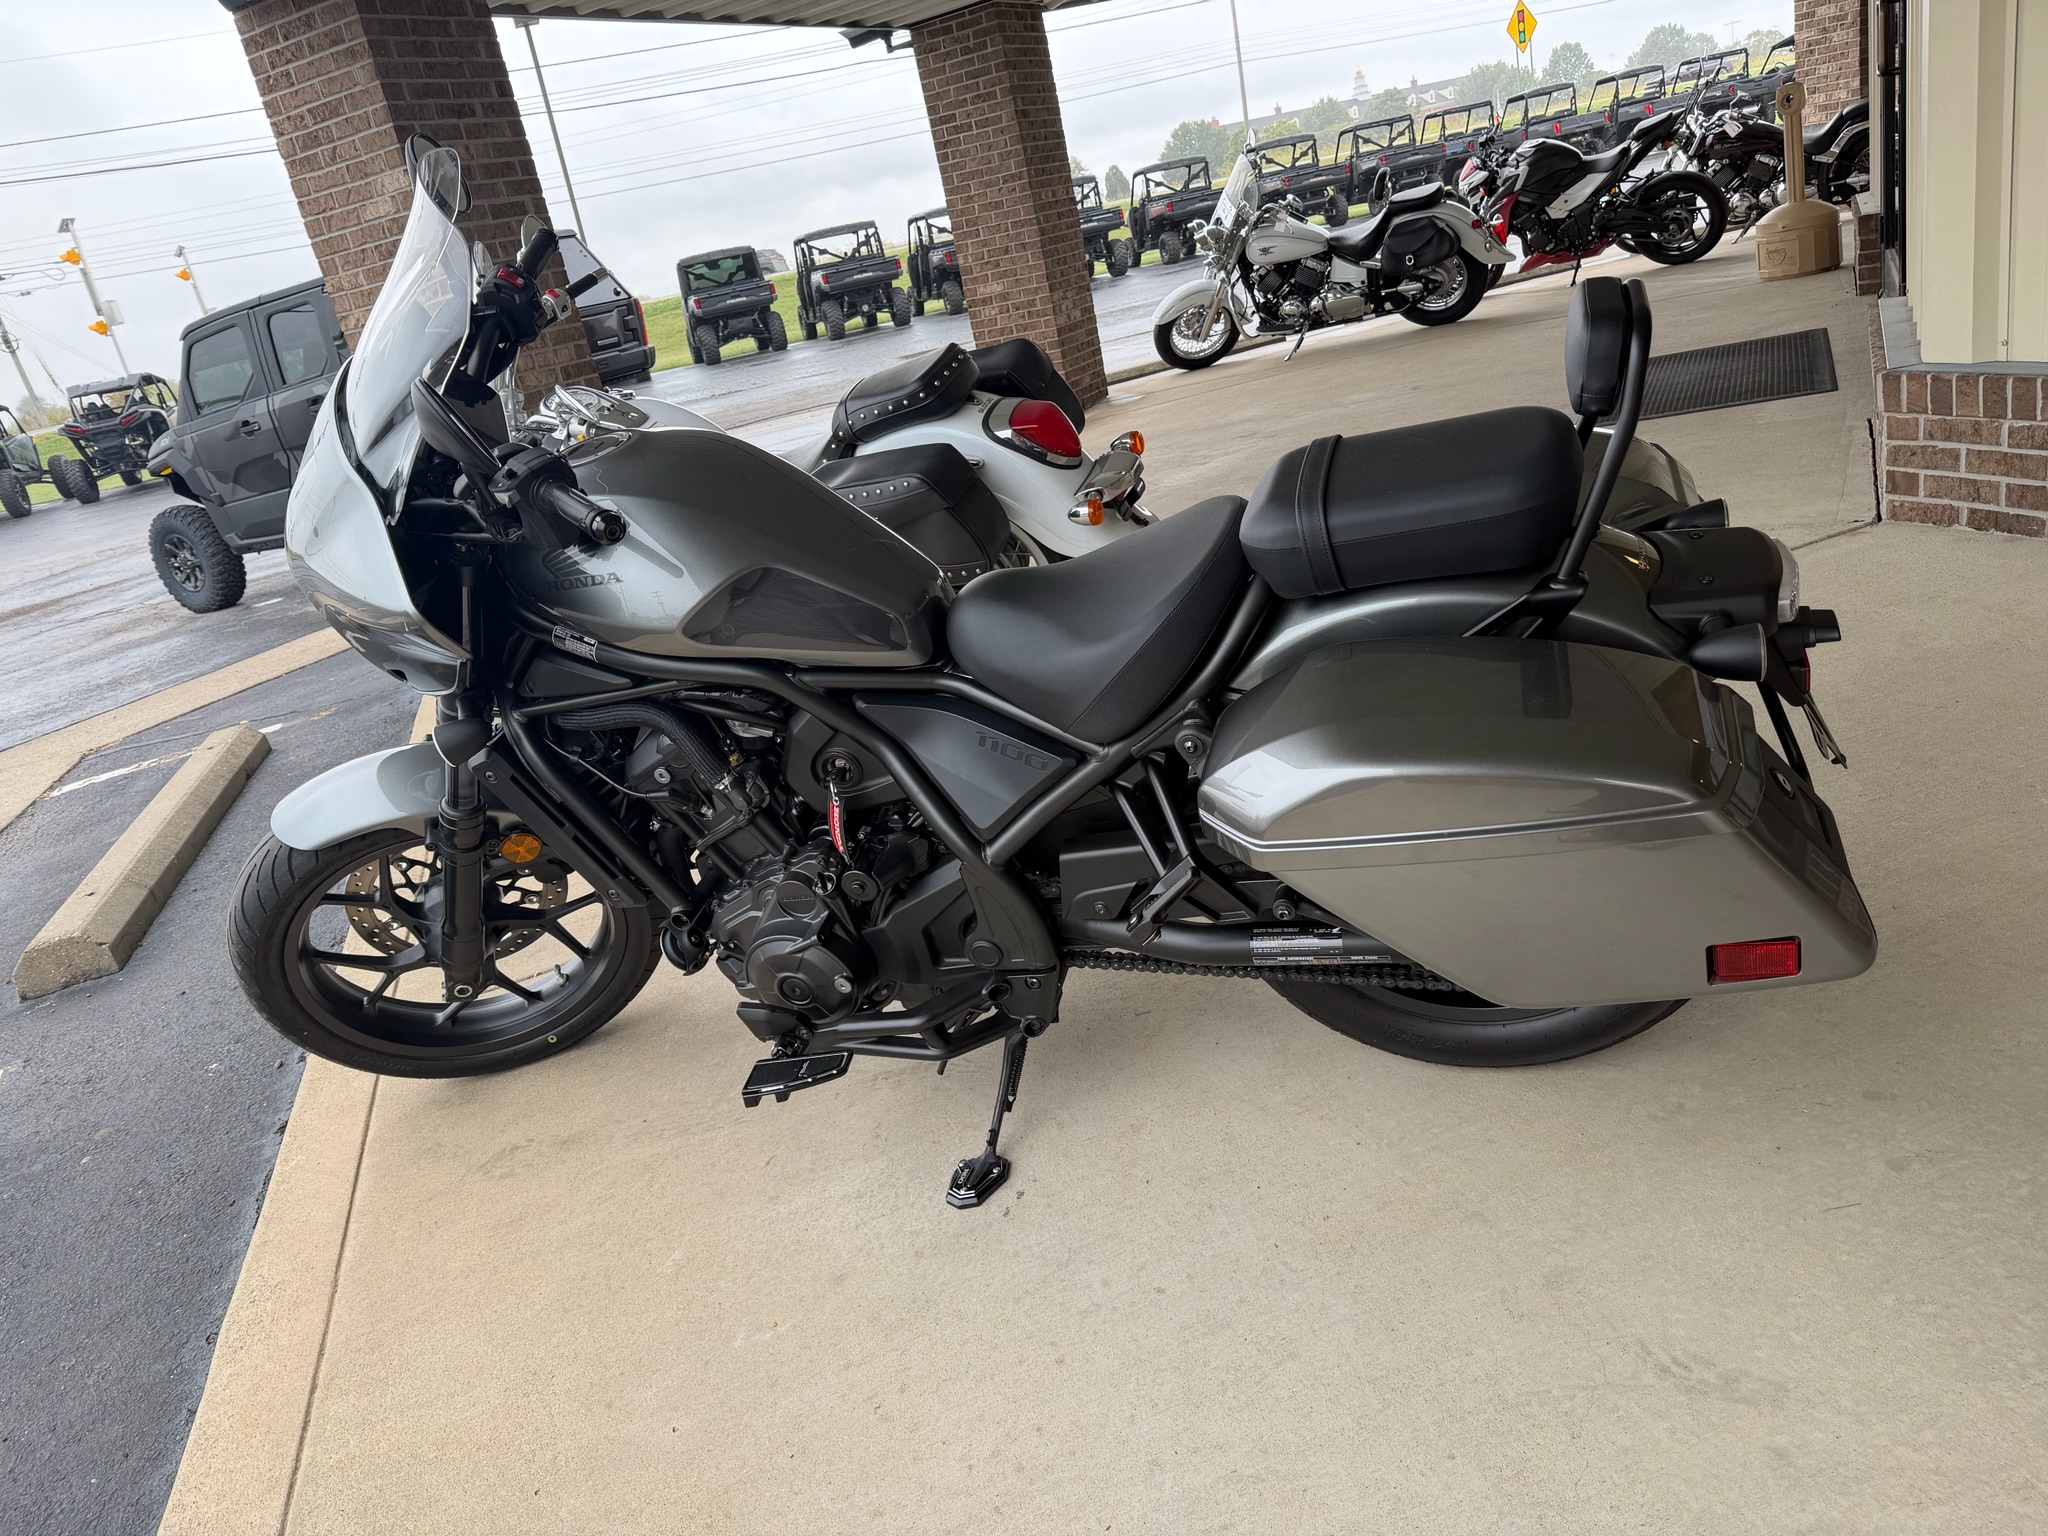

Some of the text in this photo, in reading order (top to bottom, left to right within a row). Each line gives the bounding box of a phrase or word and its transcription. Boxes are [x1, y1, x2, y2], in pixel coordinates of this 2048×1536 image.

[977, 397, 995, 414] SUZUKI
[545, 571, 623, 594] HONDA
[975, 731, 1049, 773] 1100
[957, 1168, 970, 1184] 1100
